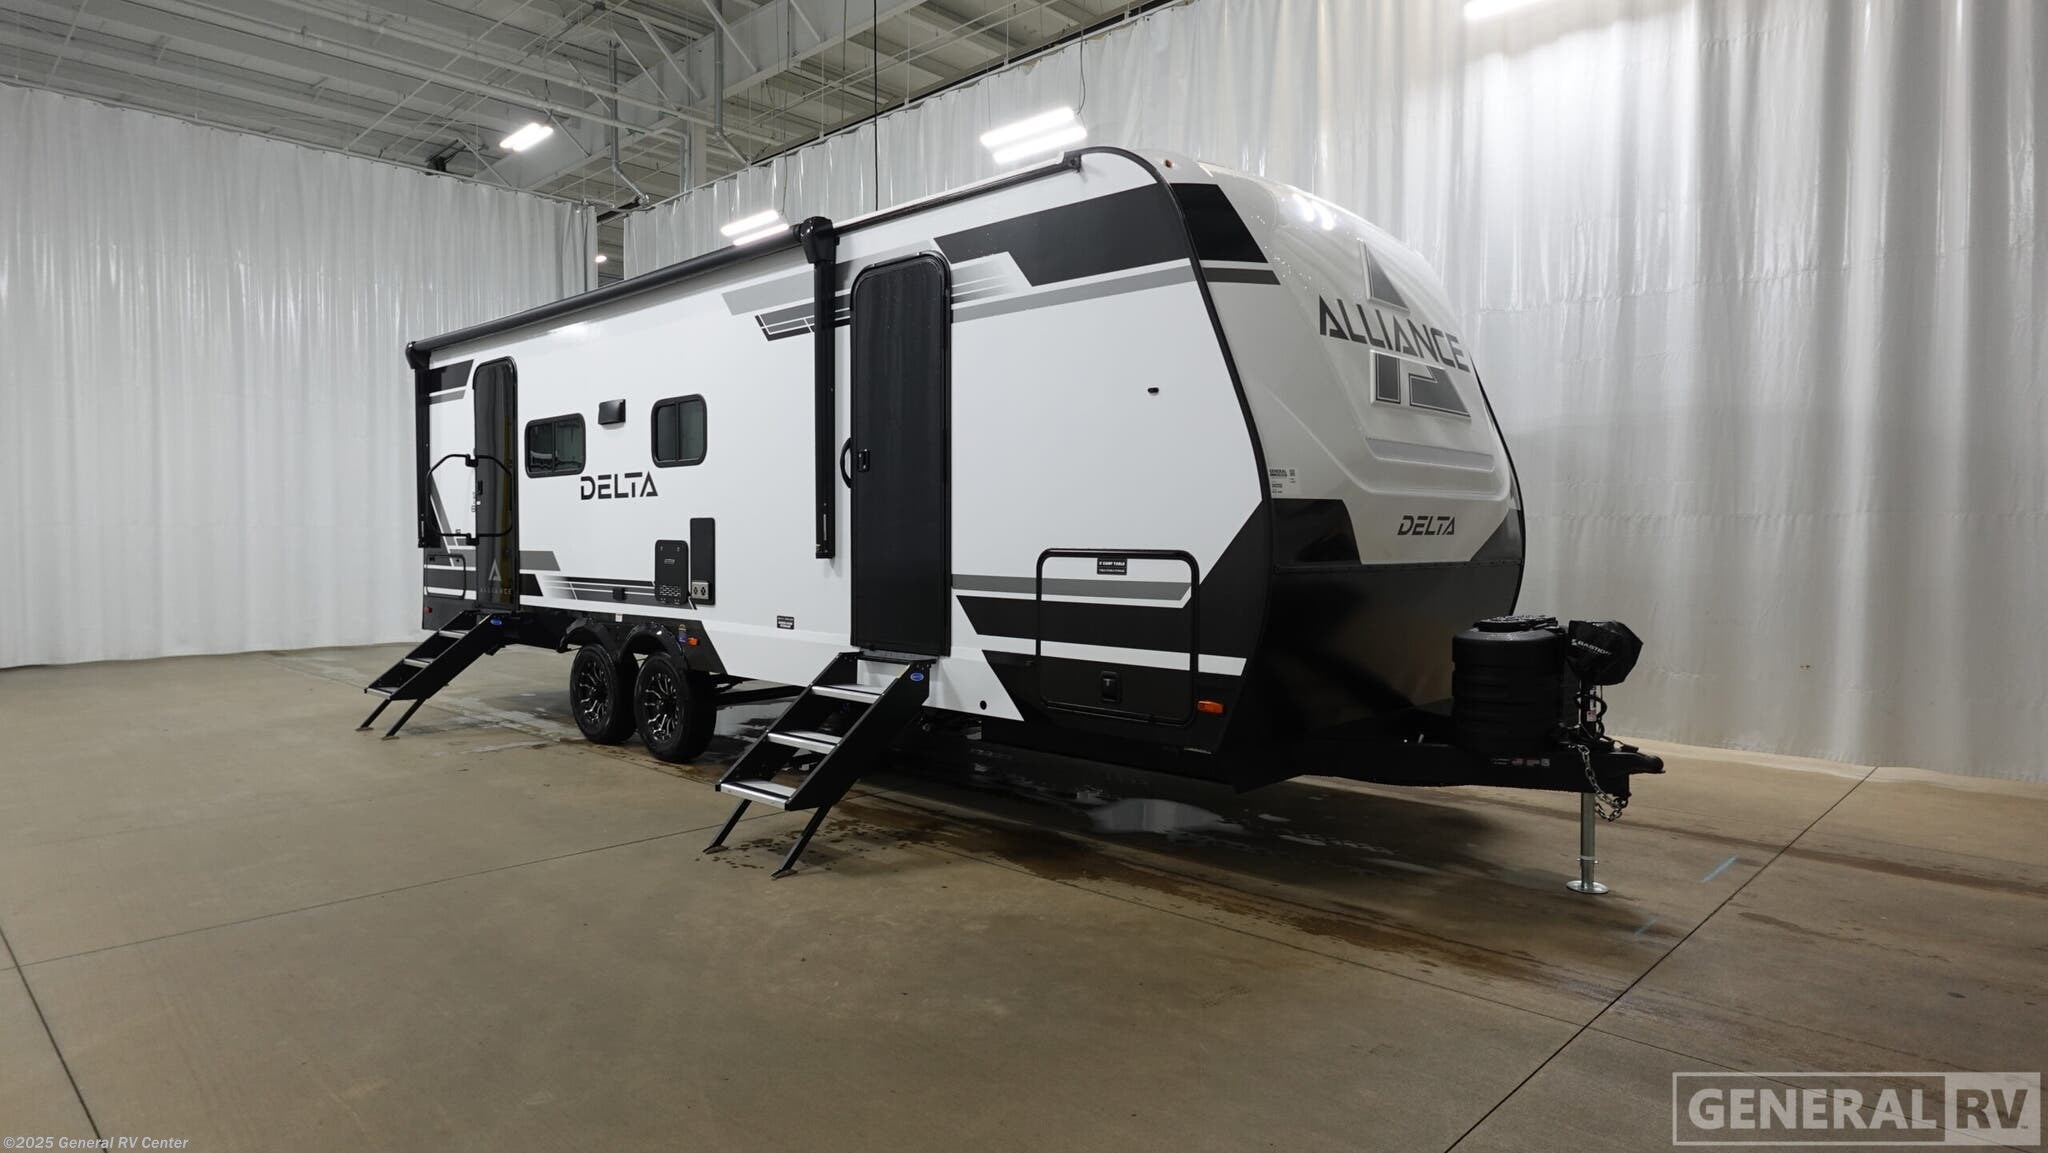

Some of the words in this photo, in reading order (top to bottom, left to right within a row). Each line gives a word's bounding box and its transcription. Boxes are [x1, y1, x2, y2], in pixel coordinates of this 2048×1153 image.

[1319, 294, 1471, 373] ALLIANCE
[580, 470, 658, 500] DELTA
[1397, 515, 1455, 536] DELTA
